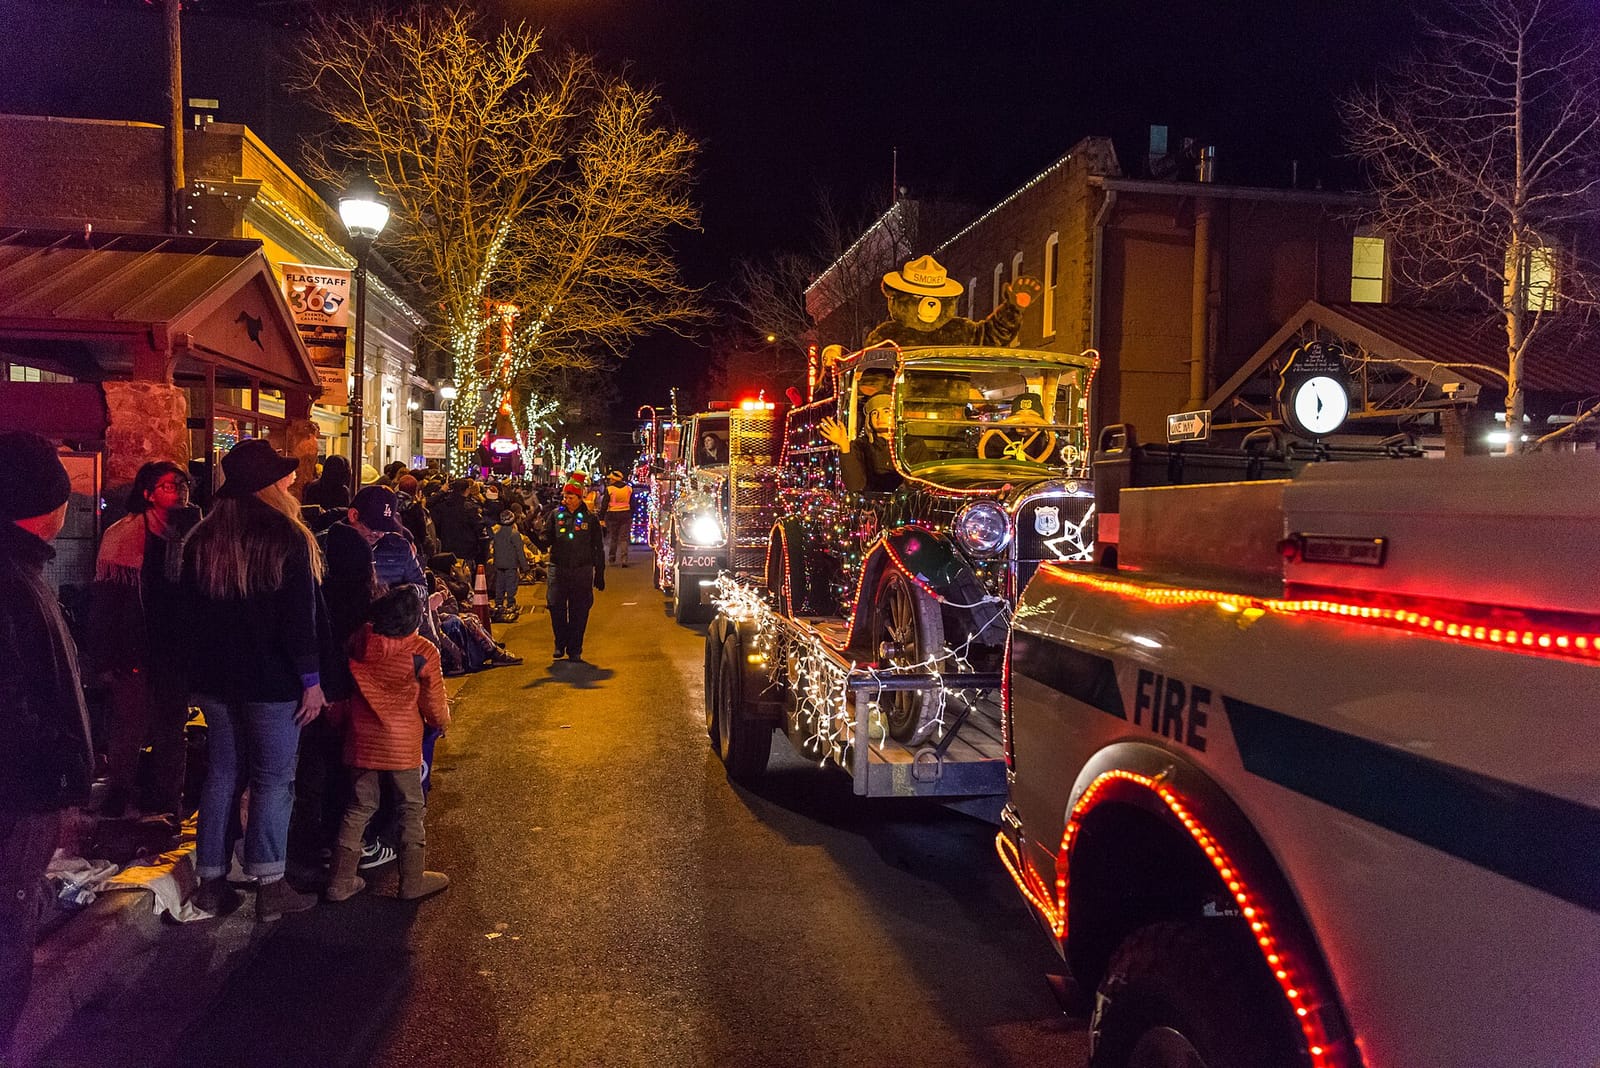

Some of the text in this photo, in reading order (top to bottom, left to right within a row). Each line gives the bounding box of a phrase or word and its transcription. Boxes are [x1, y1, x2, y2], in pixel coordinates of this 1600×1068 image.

[286, 273, 347, 286] FLAGSTAFF
[289, 286, 344, 315] 365
[1171, 420, 1195, 434] ONE WAY
[383, 503, 392, 517] LA
[681, 556, 717, 567] AZ-COF
[1134, 668, 1212, 753] FIRE
